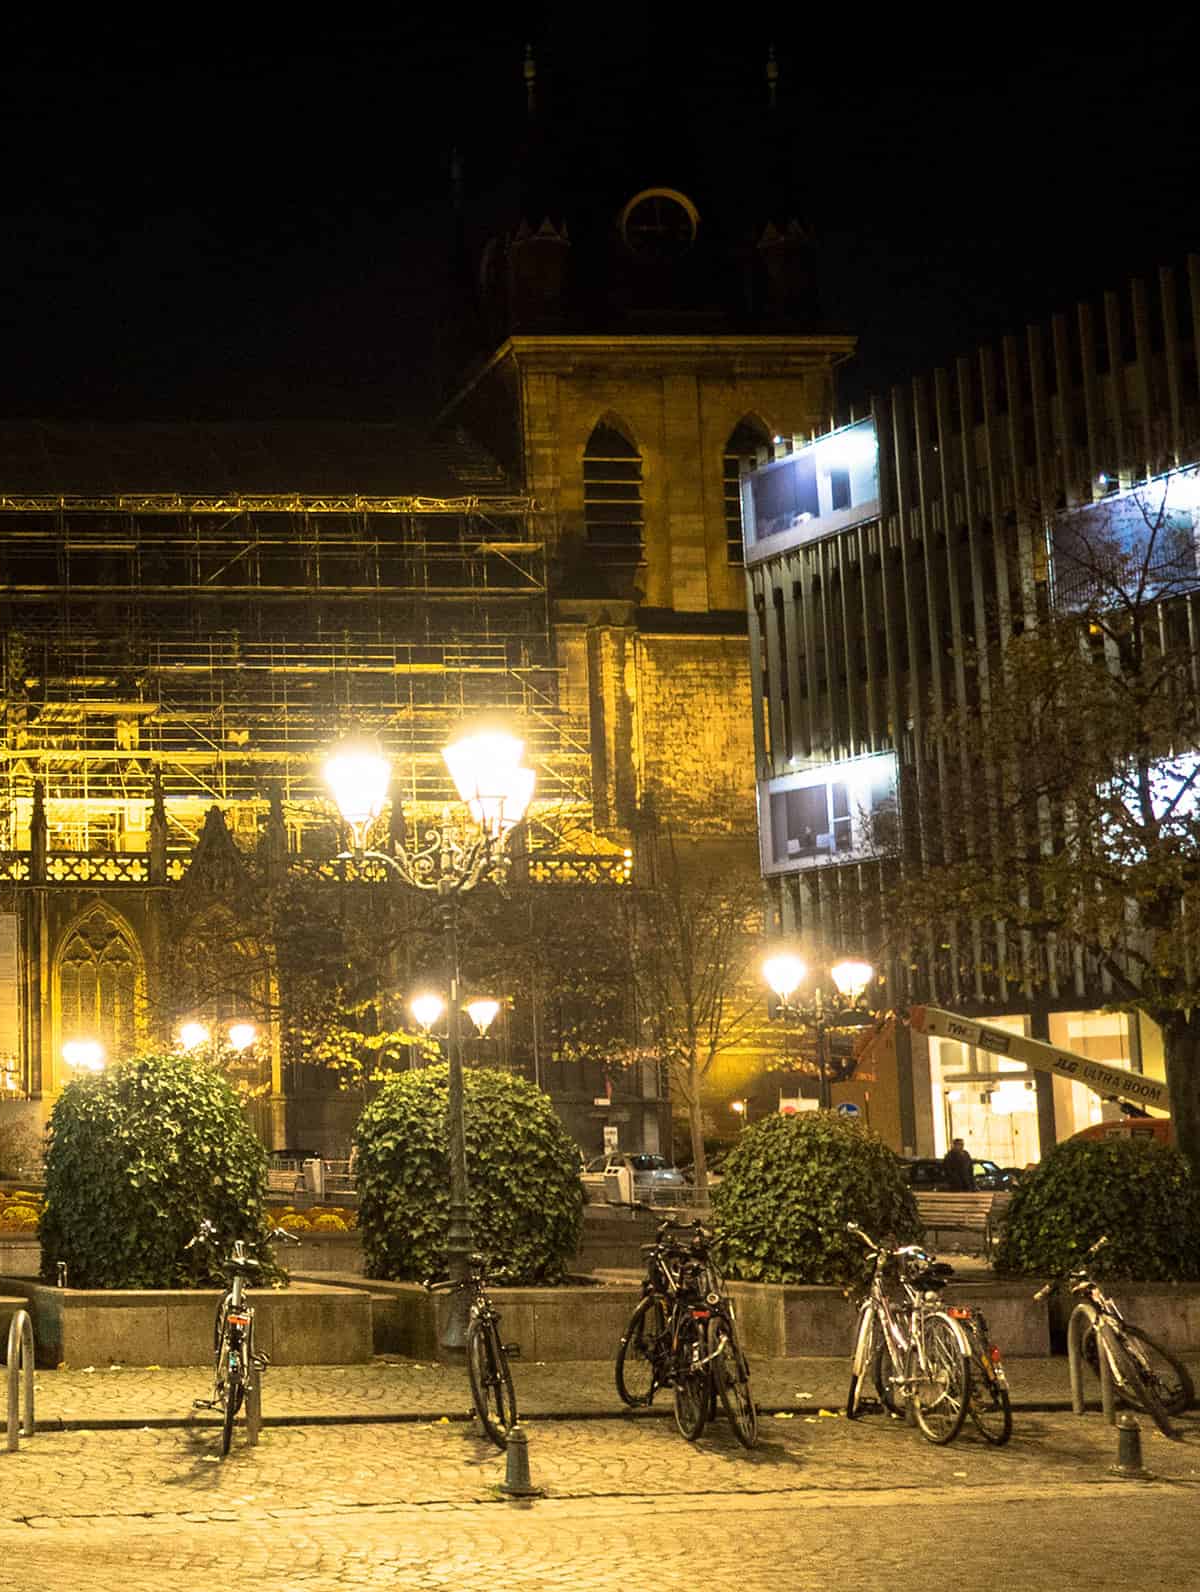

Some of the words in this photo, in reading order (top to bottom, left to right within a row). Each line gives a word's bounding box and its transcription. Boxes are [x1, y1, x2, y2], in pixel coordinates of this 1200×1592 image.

[1053, 1058, 1079, 1073] JLG
[1083, 1066, 1120, 1087] ULTRA
[1122, 1079, 1161, 1101] BOOM
